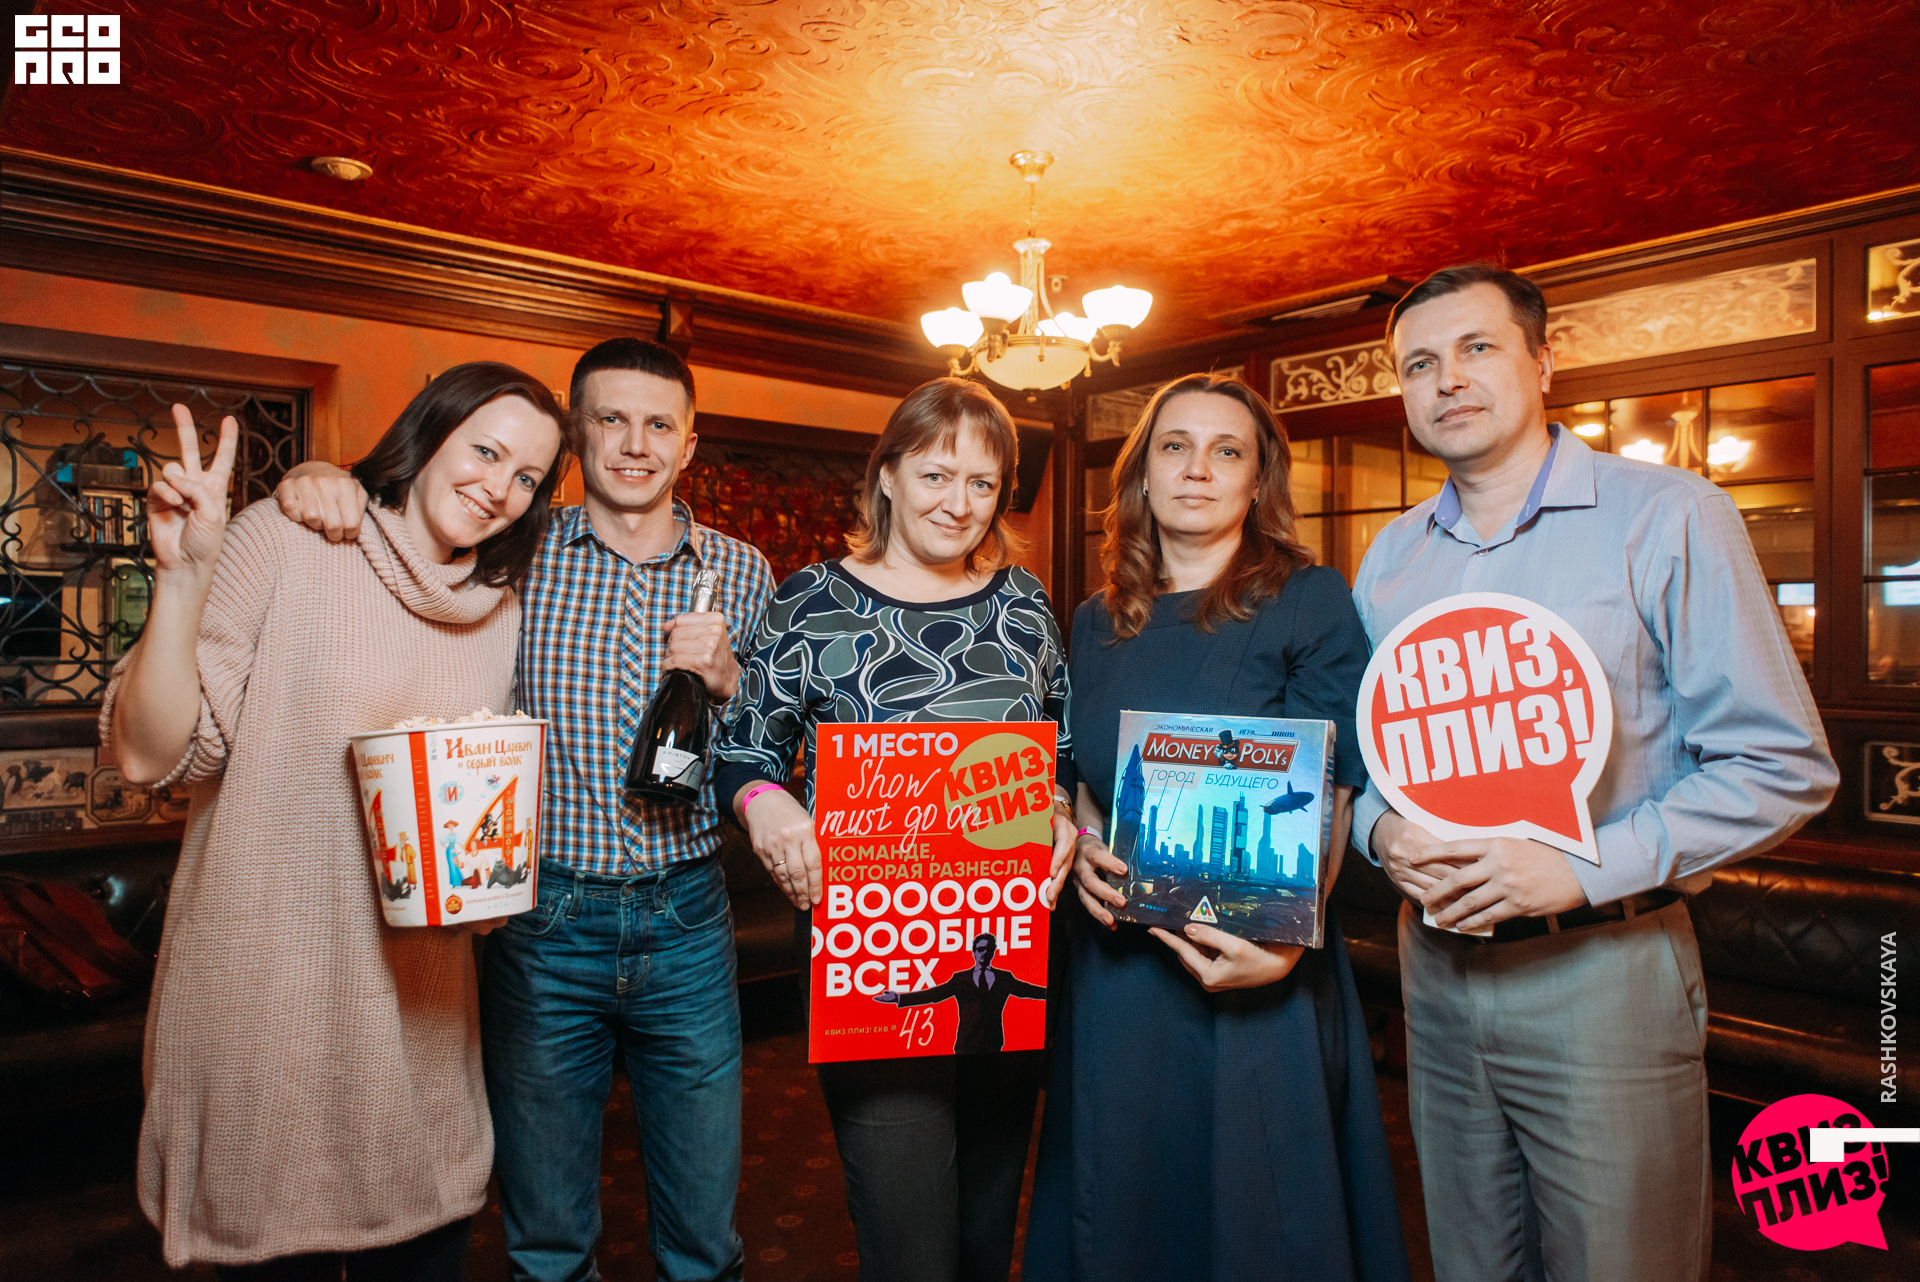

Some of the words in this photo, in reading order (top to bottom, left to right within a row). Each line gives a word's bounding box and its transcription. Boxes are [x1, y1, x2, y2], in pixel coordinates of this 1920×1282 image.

[1381, 617, 1574, 714] КВИЗ,
[831, 733, 844, 758] 1
[854, 731, 958, 758] МЕСТО
[1154, 723, 1214, 734] ЭКОНОМИЧЕСКАЯ
[1239, 728, 1256, 736] ИГРА
[1381, 688, 1592, 786] ПЛИЗ!
[1146, 737, 1215, 761] MONEY
[847, 757, 941, 799] Show
[1152, 769, 1195, 785] ГОРОД
[1205, 773, 1279, 790] БУДУЩЕГО
[820, 802, 893, 837] must
[901, 804, 937, 853] go
[946, 804, 993, 830] on
[828, 843, 935, 862] КОМАНДЕ,
[828, 863, 922, 882] КОТОРАЯ
[929, 859, 1032, 879] РАЗНЕСЛА
[826, 958, 940, 997] ВСЕХ
[899, 1007, 934, 1049] 43
